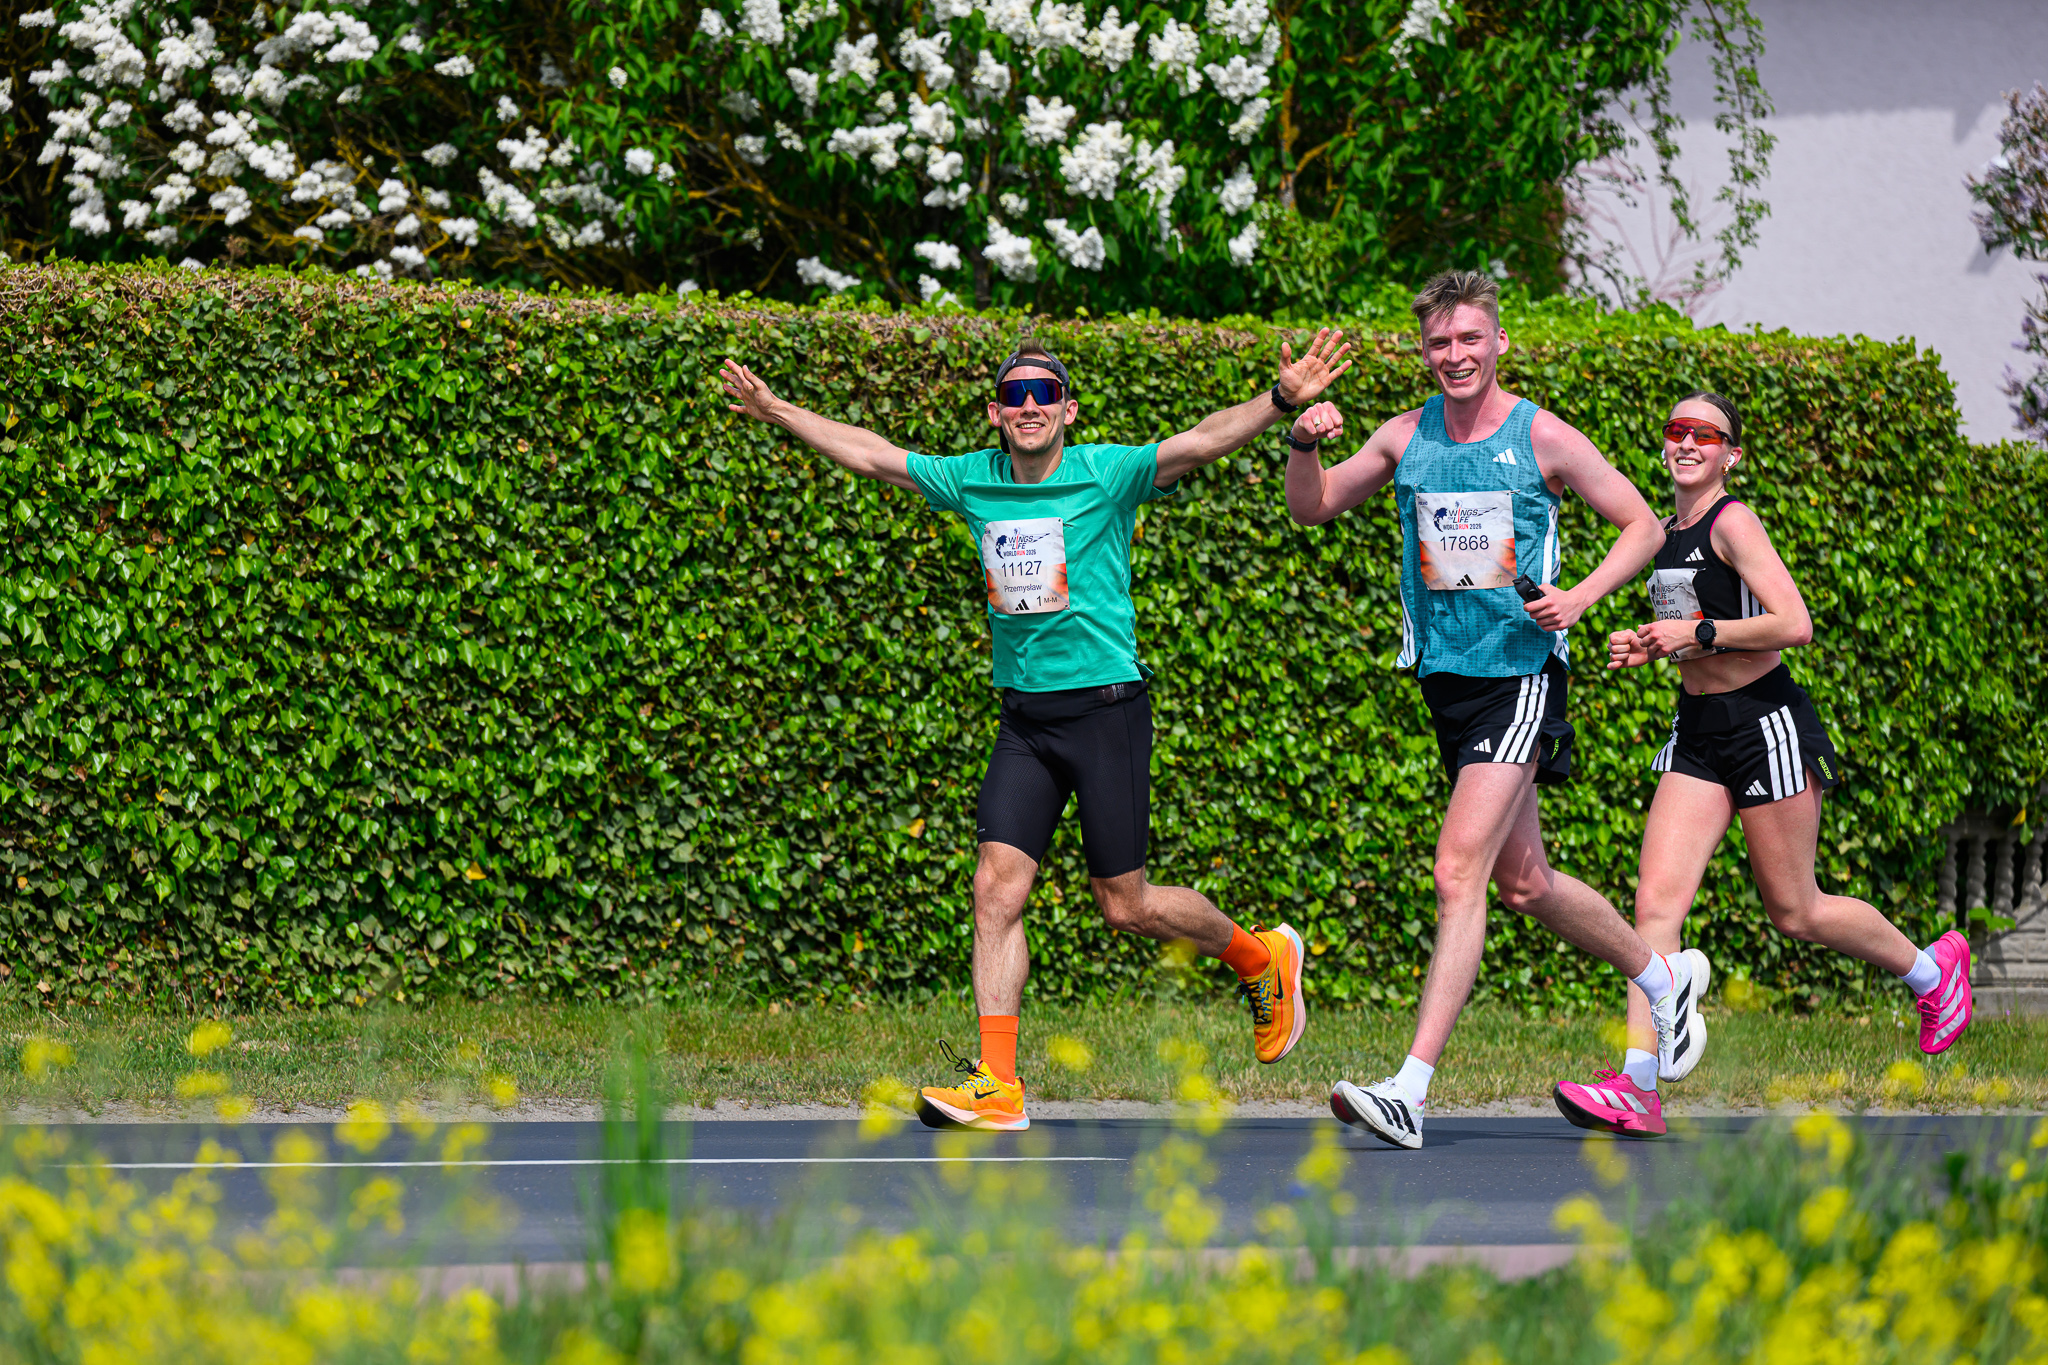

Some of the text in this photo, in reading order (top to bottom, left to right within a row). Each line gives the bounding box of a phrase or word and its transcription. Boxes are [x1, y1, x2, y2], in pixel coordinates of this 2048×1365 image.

[1448, 508, 1478, 517] WINGS
[1008, 535, 1033, 543] WINGS
[1440, 535, 1489, 551] 17868
[1001, 560, 1042, 577] 11127
[1004, 583, 1042, 594] Przemysław
[1036, 595, 1041, 607] 1
[1818, 756, 1833, 779] ADIZERO
